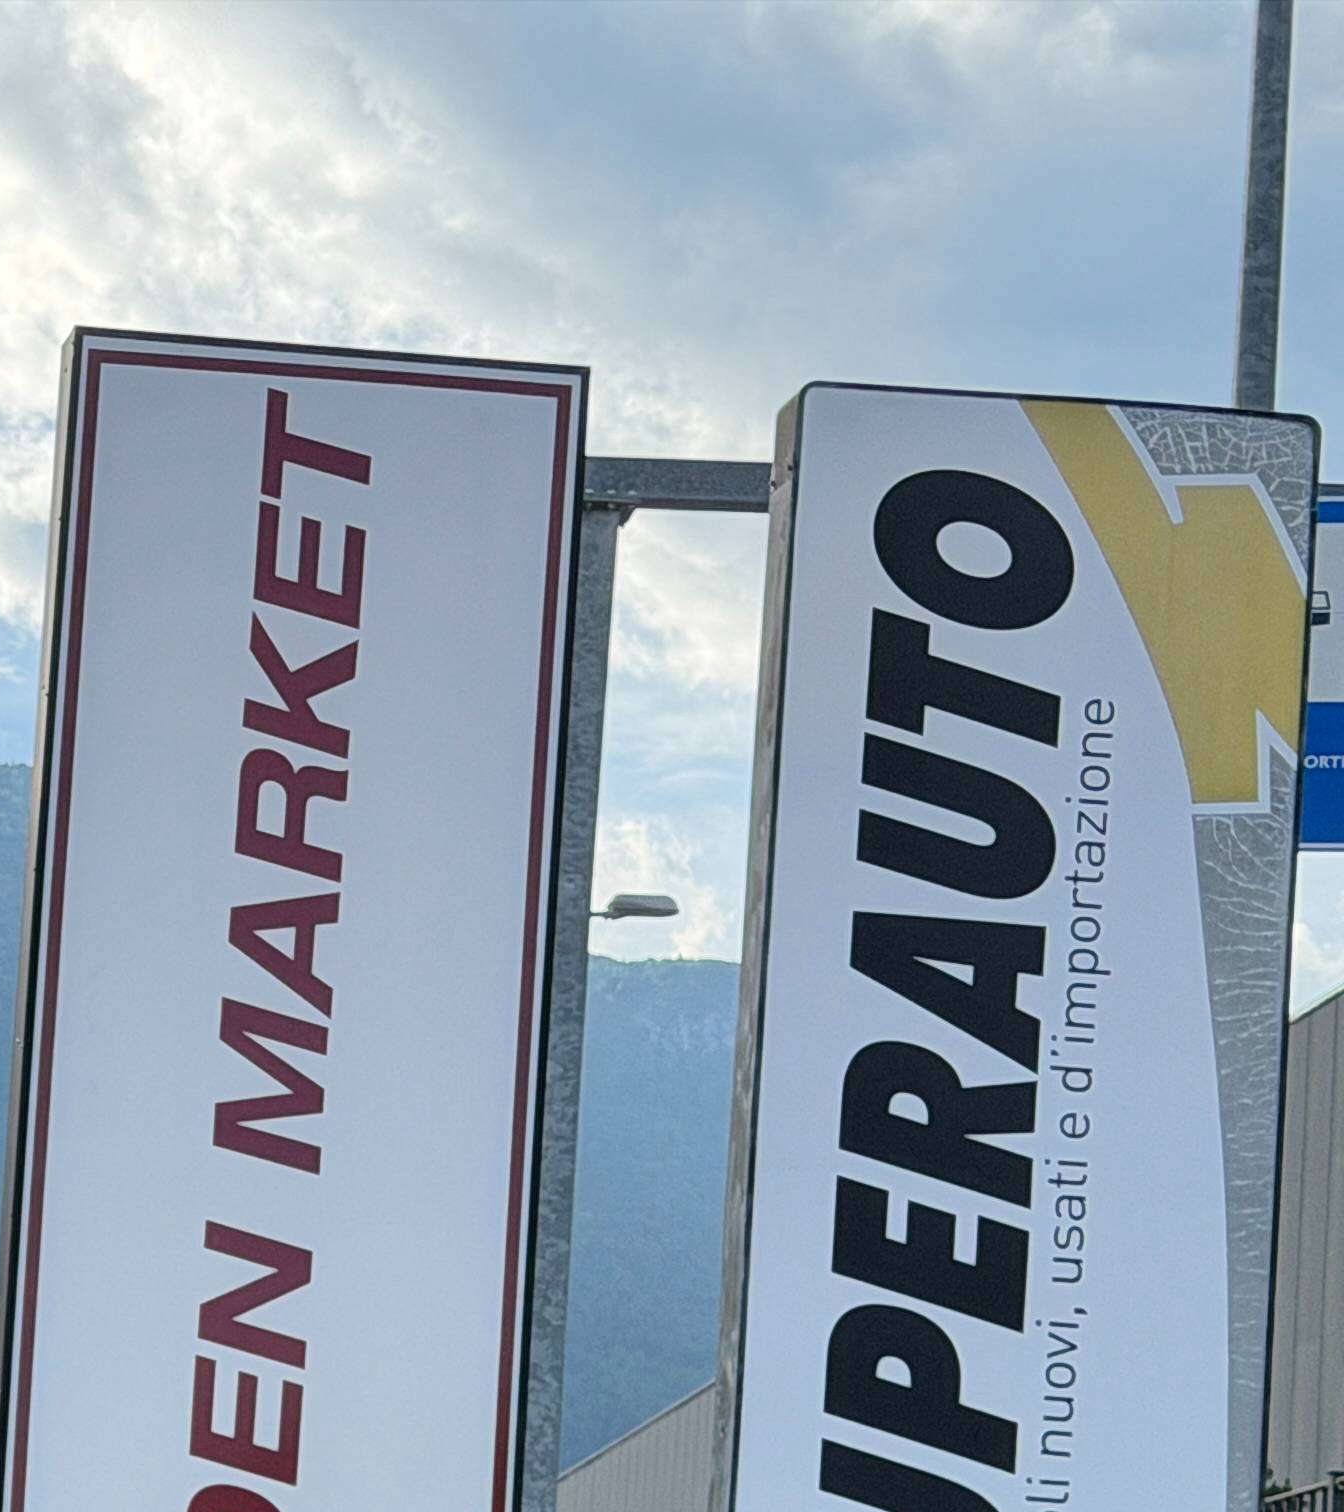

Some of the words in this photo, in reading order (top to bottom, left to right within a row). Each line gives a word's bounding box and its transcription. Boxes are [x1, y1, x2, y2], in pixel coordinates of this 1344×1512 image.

[213, 387, 372, 1176] MARKET
[1049, 698, 1114, 1093] d'importazione
[1059, 1112, 1090, 1139] e
[1045, 1160, 1088, 1284] usati
[1034, 1307, 1088, 1458] nuovi,
